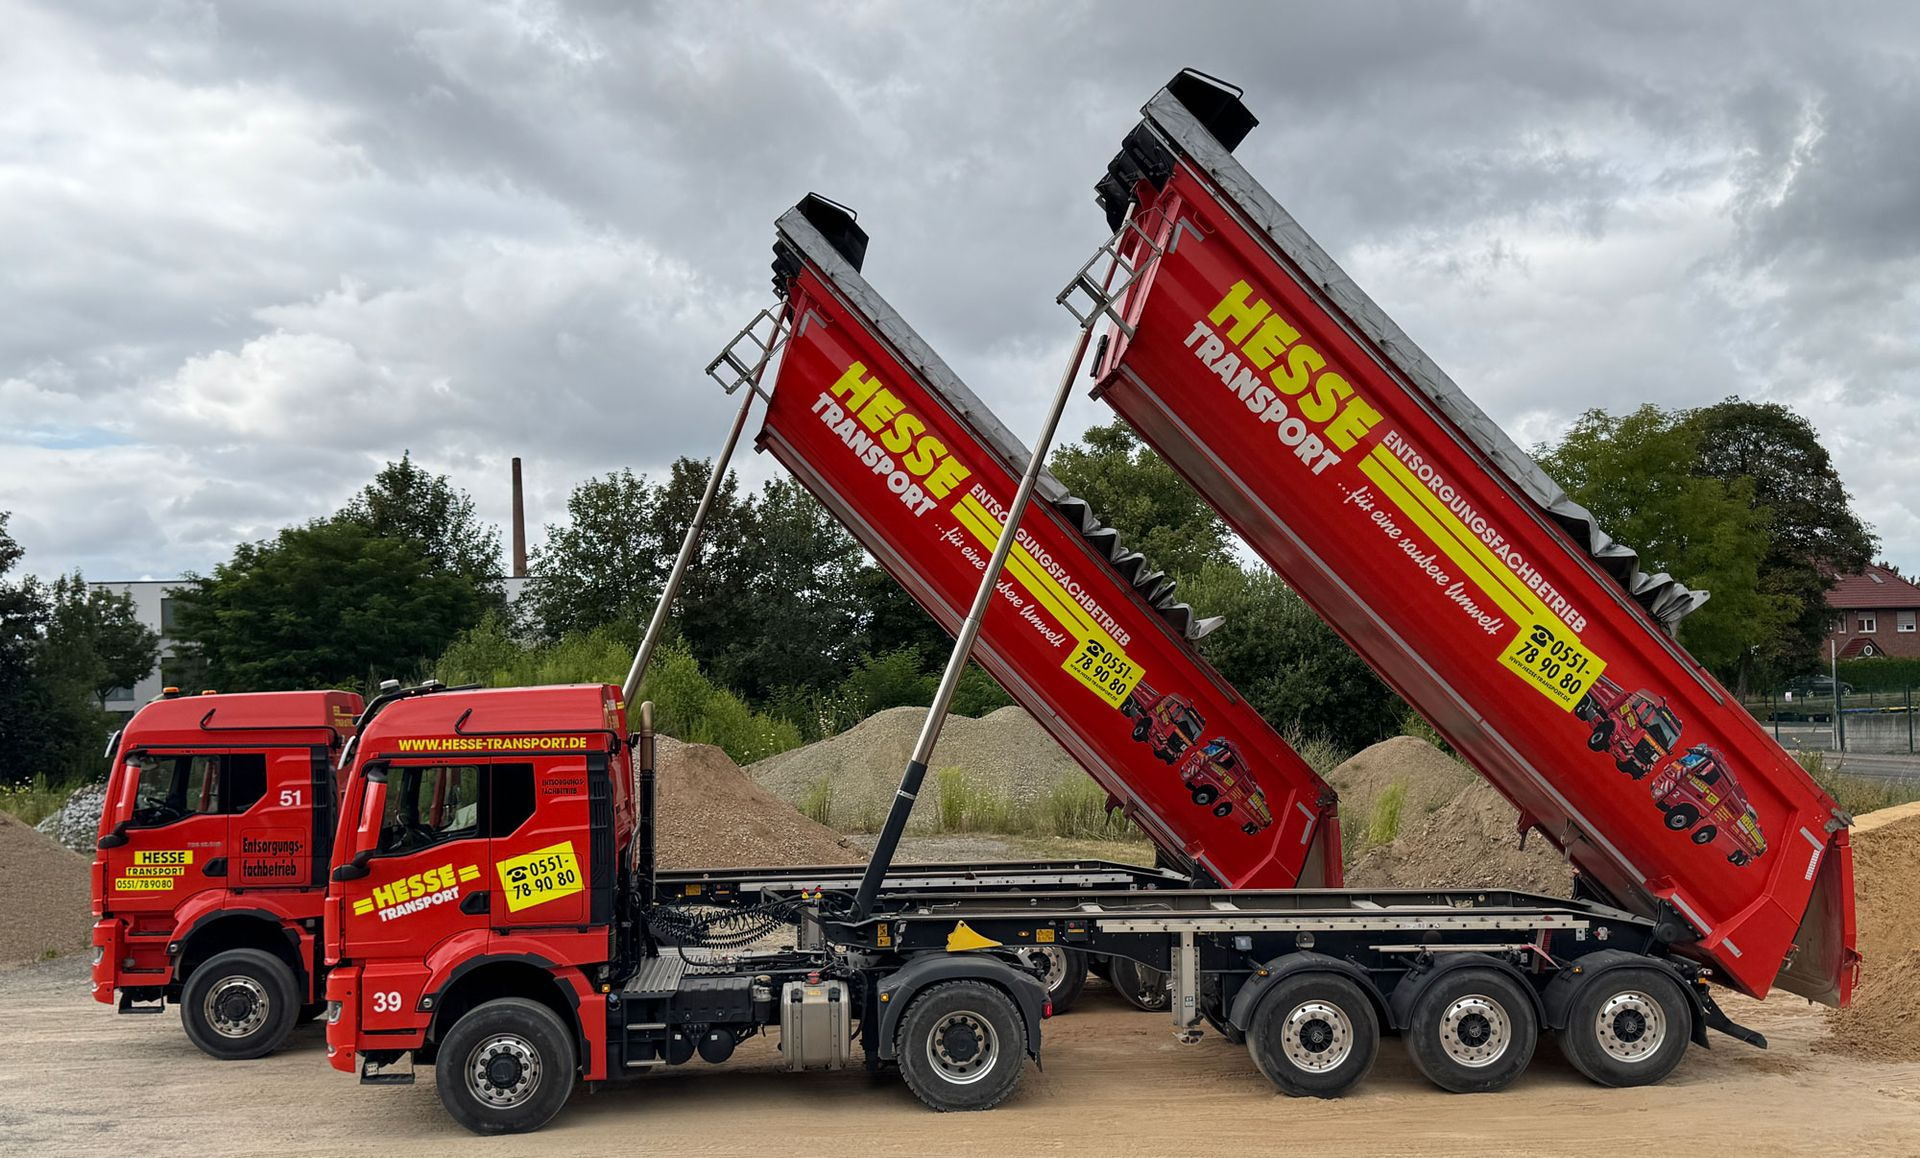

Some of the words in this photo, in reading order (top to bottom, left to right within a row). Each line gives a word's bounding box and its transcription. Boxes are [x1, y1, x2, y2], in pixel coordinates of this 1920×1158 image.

[1207, 279, 1384, 453] HESSE
[1183, 320, 1342, 476] TRANSPORT
[830, 360, 972, 500] HESSE
[811, 392, 938, 518] TRANSPORT
[1382, 430, 1588, 633] ENTSORGUNGSFACHBETRIEB
[969, 482, 1132, 647] ENTSOGUNGSFACHBETRIEB
[1337, 482, 1375, 511] ...für
[1371, 510, 1402, 539] eine
[1398, 538, 1450, 586] saubere
[1444, 581, 1504, 635] Umwelt
[961, 546, 986, 570] eine
[1020, 604, 1066, 648] Umwelt
[1075, 652, 1093, 670] 78
[1093, 665, 1110, 683] 90
[1109, 678, 1127, 695] 80
[1102, 652, 1133, 680] 0551-
[1516, 641, 1539, 664] 78
[1539, 657, 1561, 679] 90
[1559, 673, 1582, 695] 80
[1550, 640, 1590, 675] 0551-
[398, 737, 587, 751] WWW.HESSE-TRANSPORT.DE
[280, 790, 301, 807] 51
[142, 851, 185, 864] HESSE
[243, 837, 304, 856] Entsorgungs-
[127, 867, 184, 876] TRANSPORT
[243, 859, 297, 877] fachbetrieb
[529, 855, 570, 877] 0551-
[372, 863, 457, 909] HESSE
[513, 882, 532, 900] 78
[535, 876, 553, 893] 90
[558, 869, 576, 886] 80
[378, 886, 459, 922] TRANSPORT
[373, 991, 402, 1013] 39
